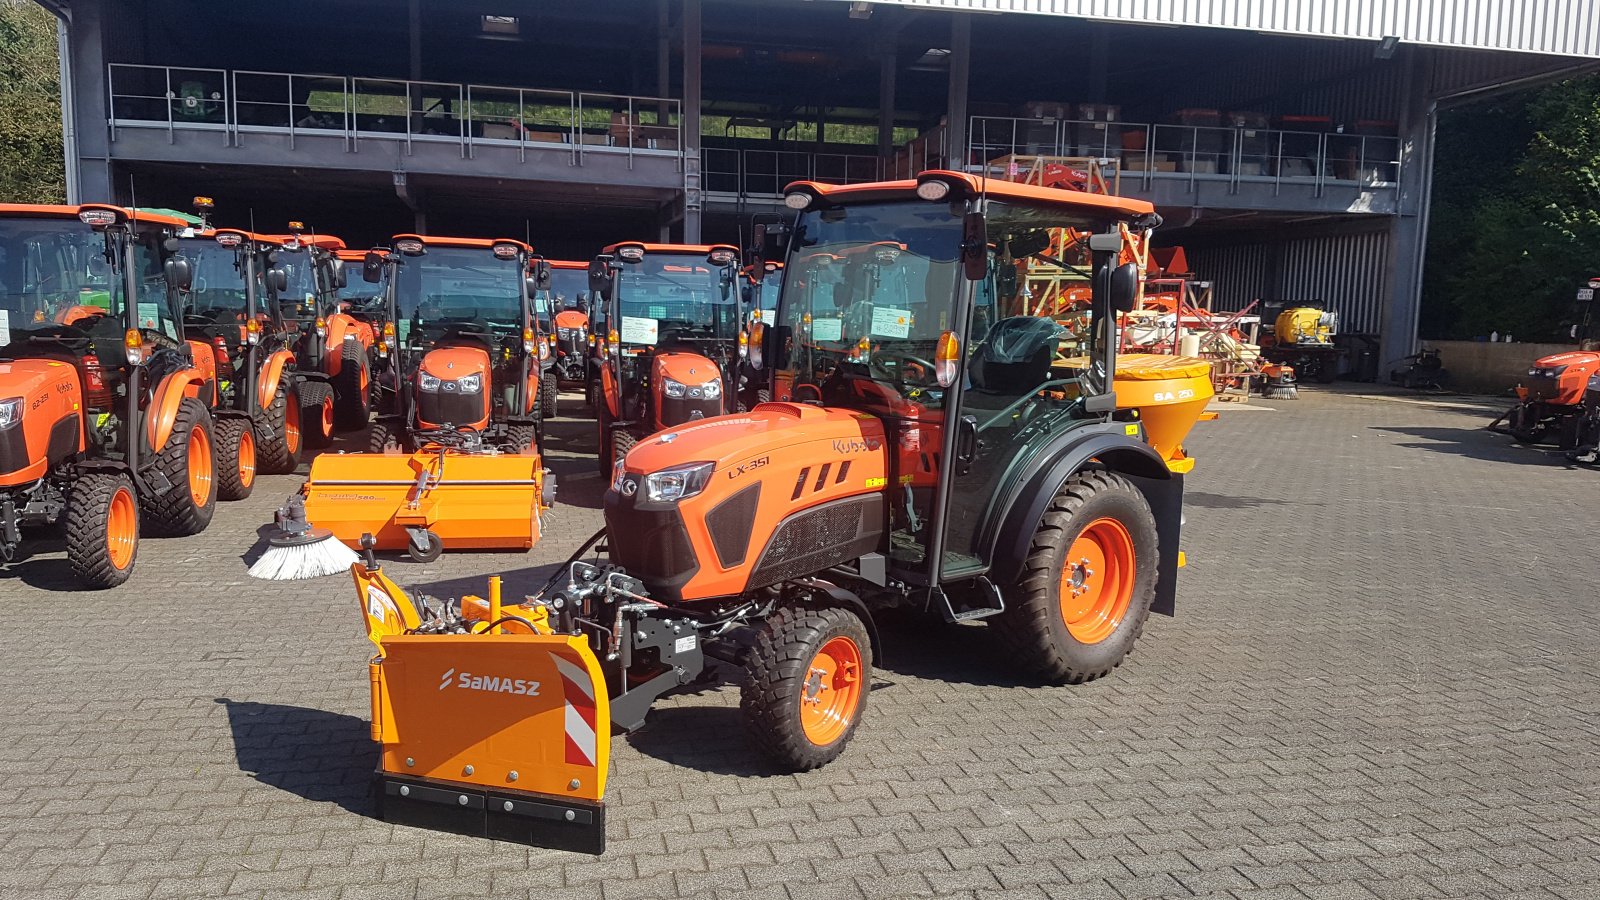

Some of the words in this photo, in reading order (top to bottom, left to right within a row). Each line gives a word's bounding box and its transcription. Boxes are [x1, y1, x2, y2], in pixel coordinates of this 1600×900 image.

[832, 435, 880, 454] Kubota
[728, 456, 770, 480] LX-351
[458, 672, 540, 696] SaMASZ
